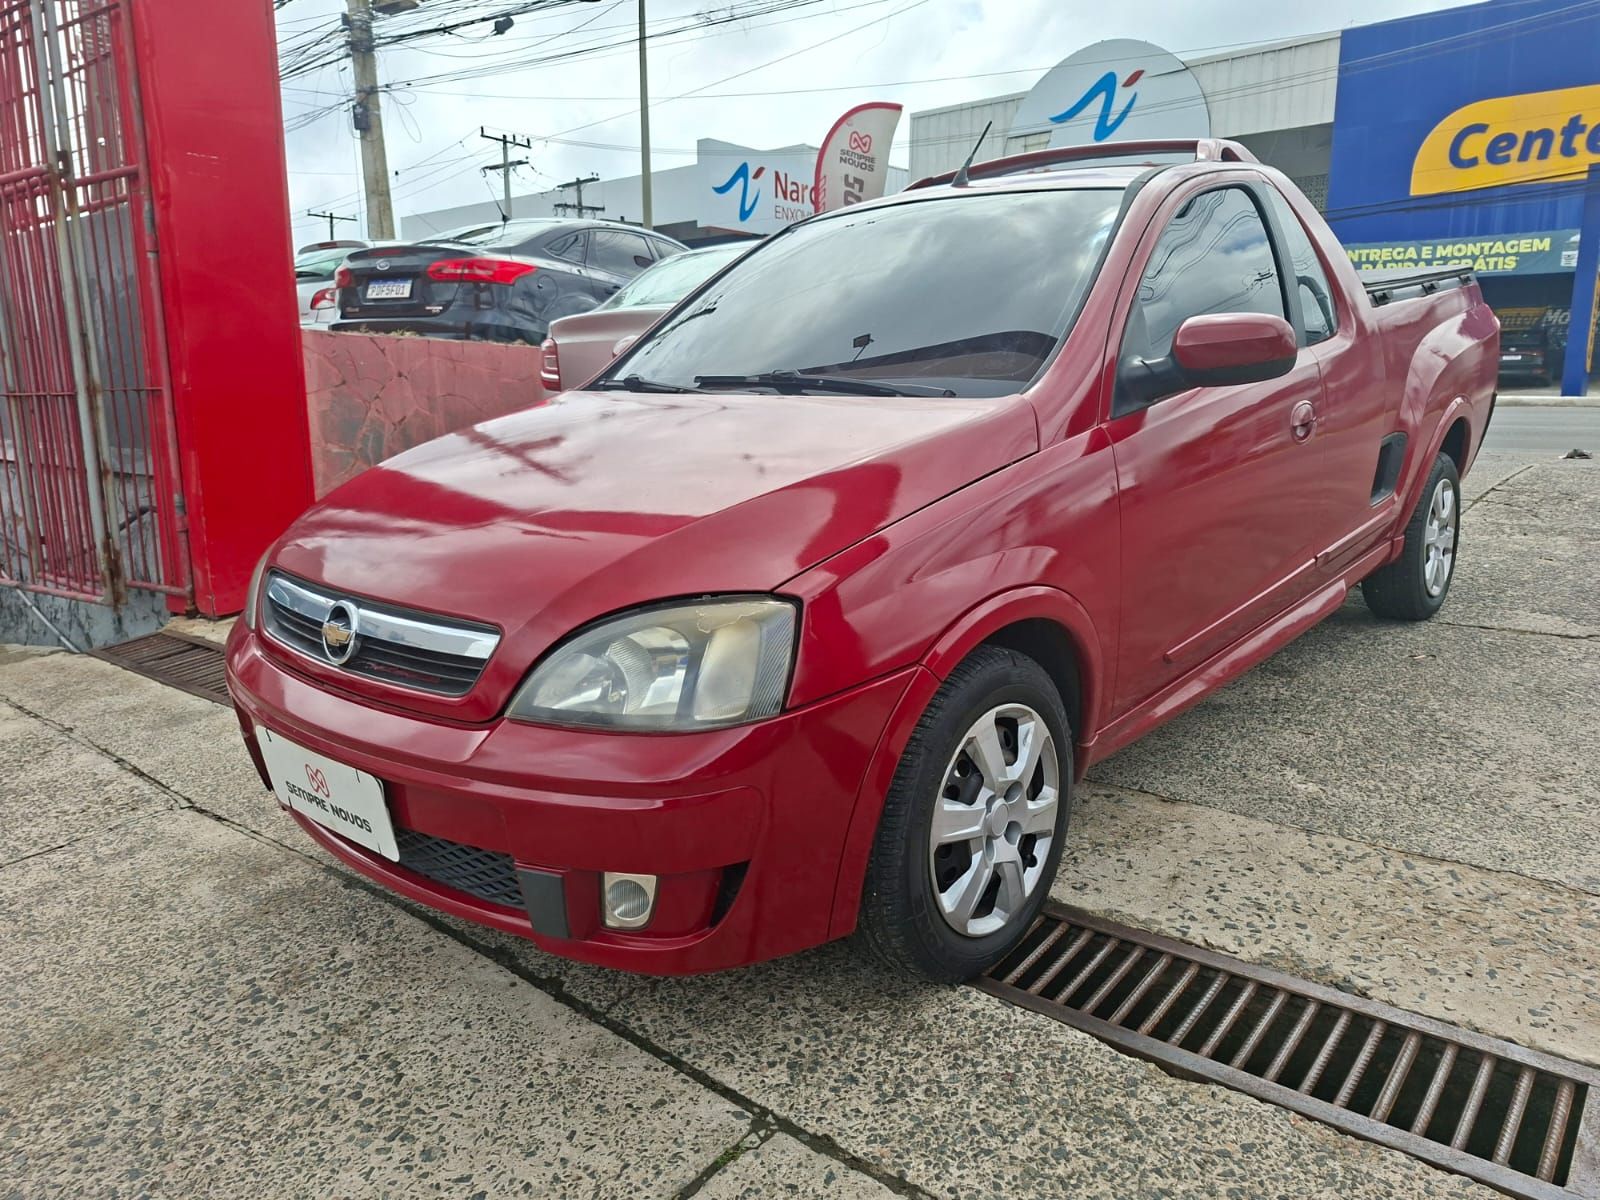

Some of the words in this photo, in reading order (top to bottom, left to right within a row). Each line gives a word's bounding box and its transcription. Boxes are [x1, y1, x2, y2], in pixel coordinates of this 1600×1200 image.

[839, 156, 875, 172] NOVOS
[840, 149, 876, 164] SEMPRE
[1347, 246, 1418, 262] NTREGA
[1421, 246, 1433, 259] E
[1436, 237, 1551, 258] MONTAGEM
[285, 780, 329, 812] SEMPRE
[330, 803, 372, 833] NOVOS
